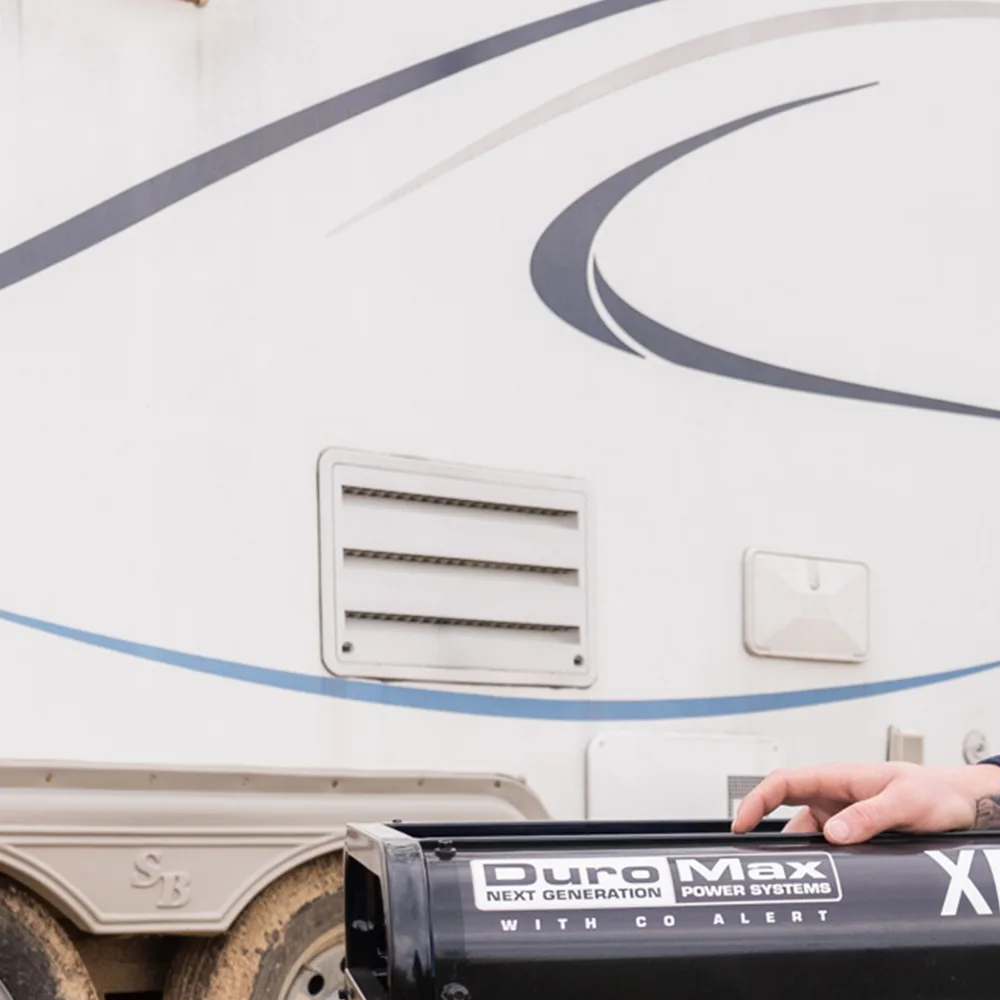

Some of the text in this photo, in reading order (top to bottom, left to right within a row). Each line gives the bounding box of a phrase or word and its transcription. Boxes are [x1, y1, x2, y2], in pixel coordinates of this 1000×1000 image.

[483, 858, 827, 886] Duro Max
[486, 883, 831, 901] NEXT GENERATION POWER SYSTEMS
[501, 910, 828, 931] WITH CO ALERT
